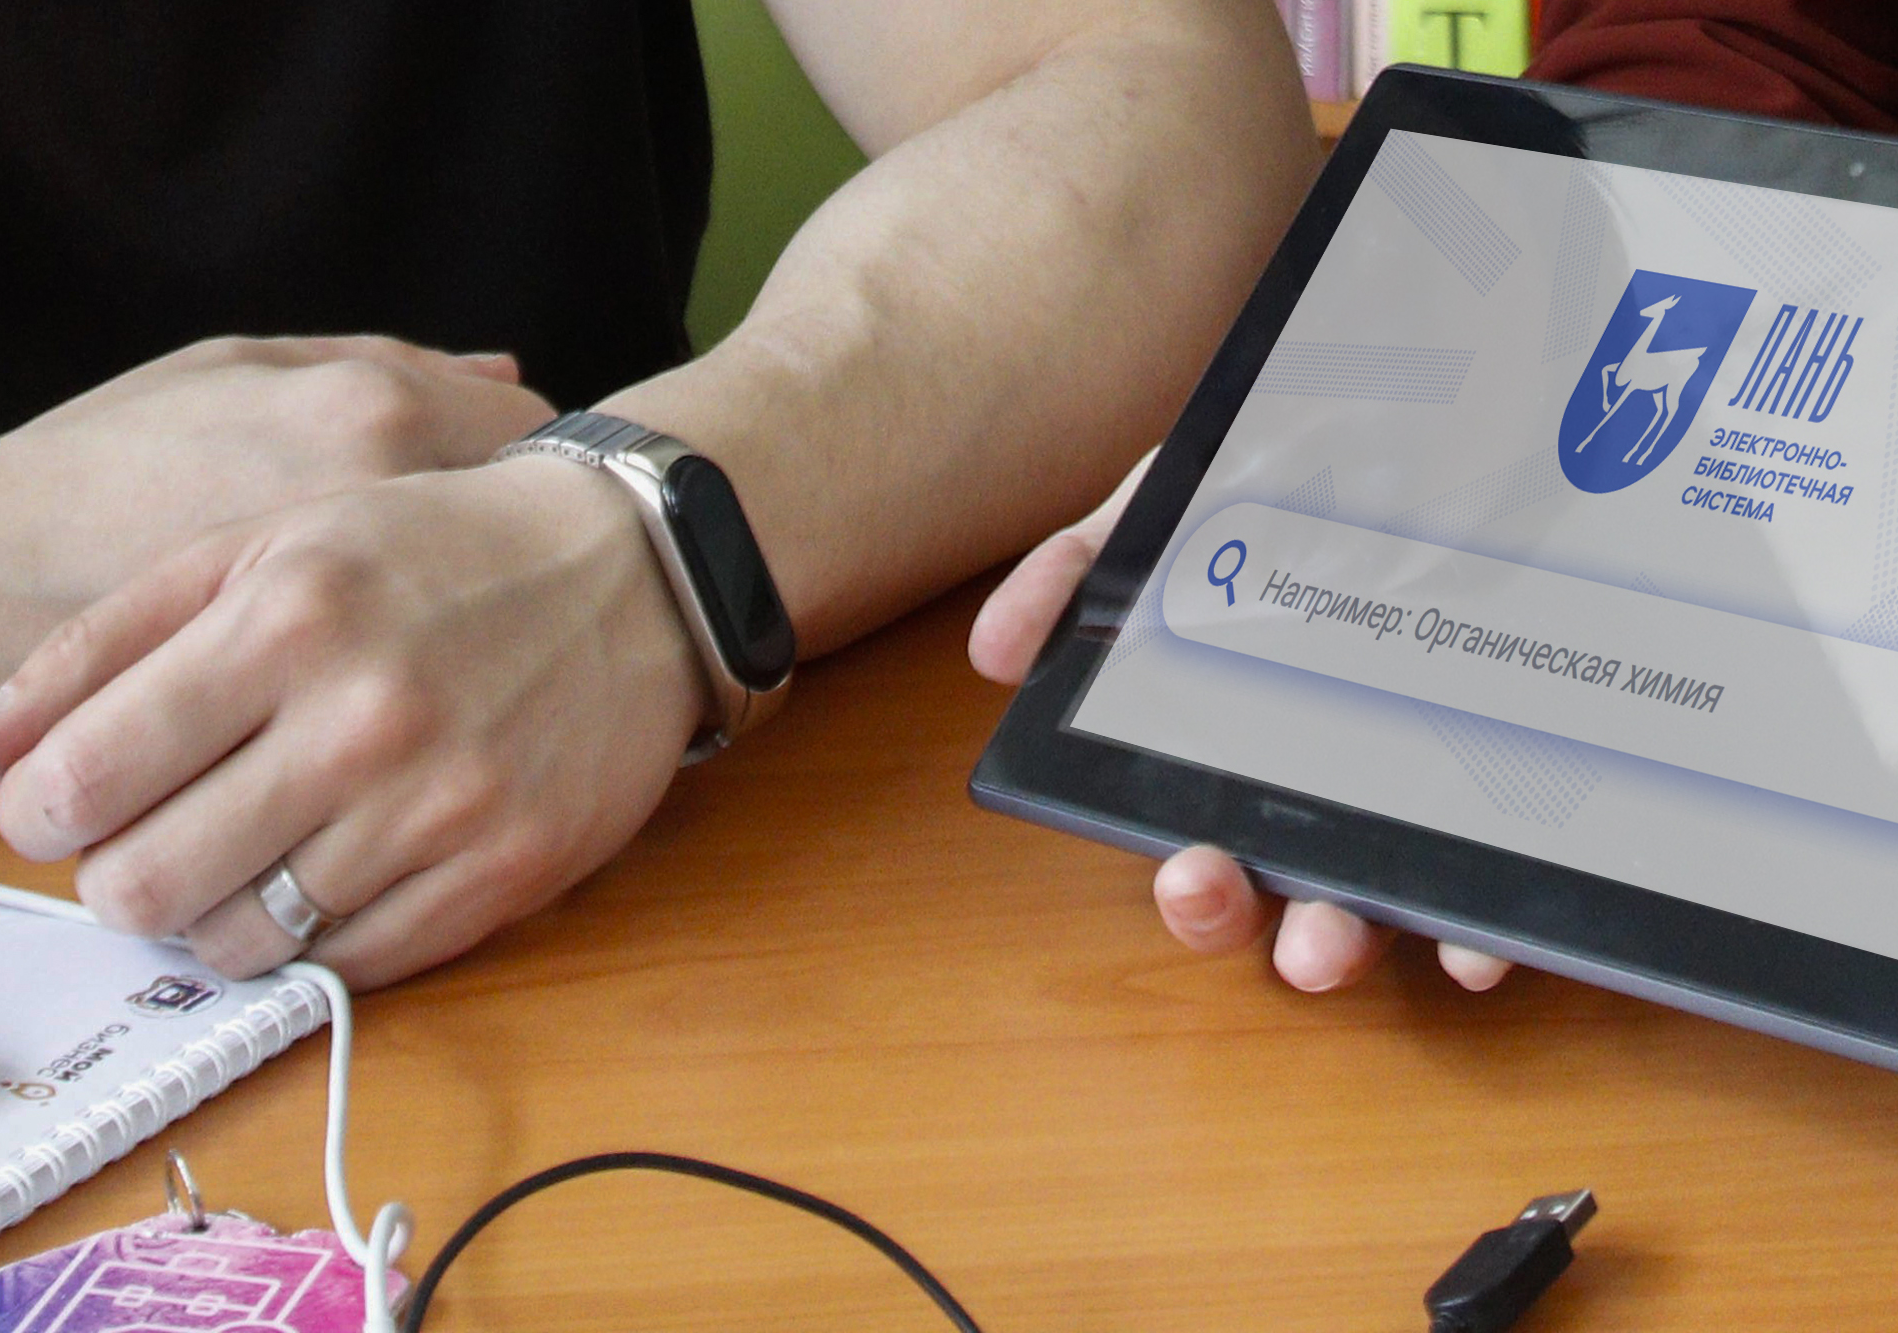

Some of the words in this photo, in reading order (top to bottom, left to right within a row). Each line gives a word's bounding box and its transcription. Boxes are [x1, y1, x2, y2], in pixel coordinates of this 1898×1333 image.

[1727, 303, 1865, 424] ЛАНЬ
[1709, 427, 1848, 471] ЭЛЕКТРОННО-
[1680, 485, 1775, 523] СИСТЕМА
[1693, 455, 1855, 506] БИБЛИОТЕЧНАЯ
[1259, 569, 1414, 640] Например:
[1413, 607, 1622, 687] Органическая
[1620, 664, 1725, 714] химия
